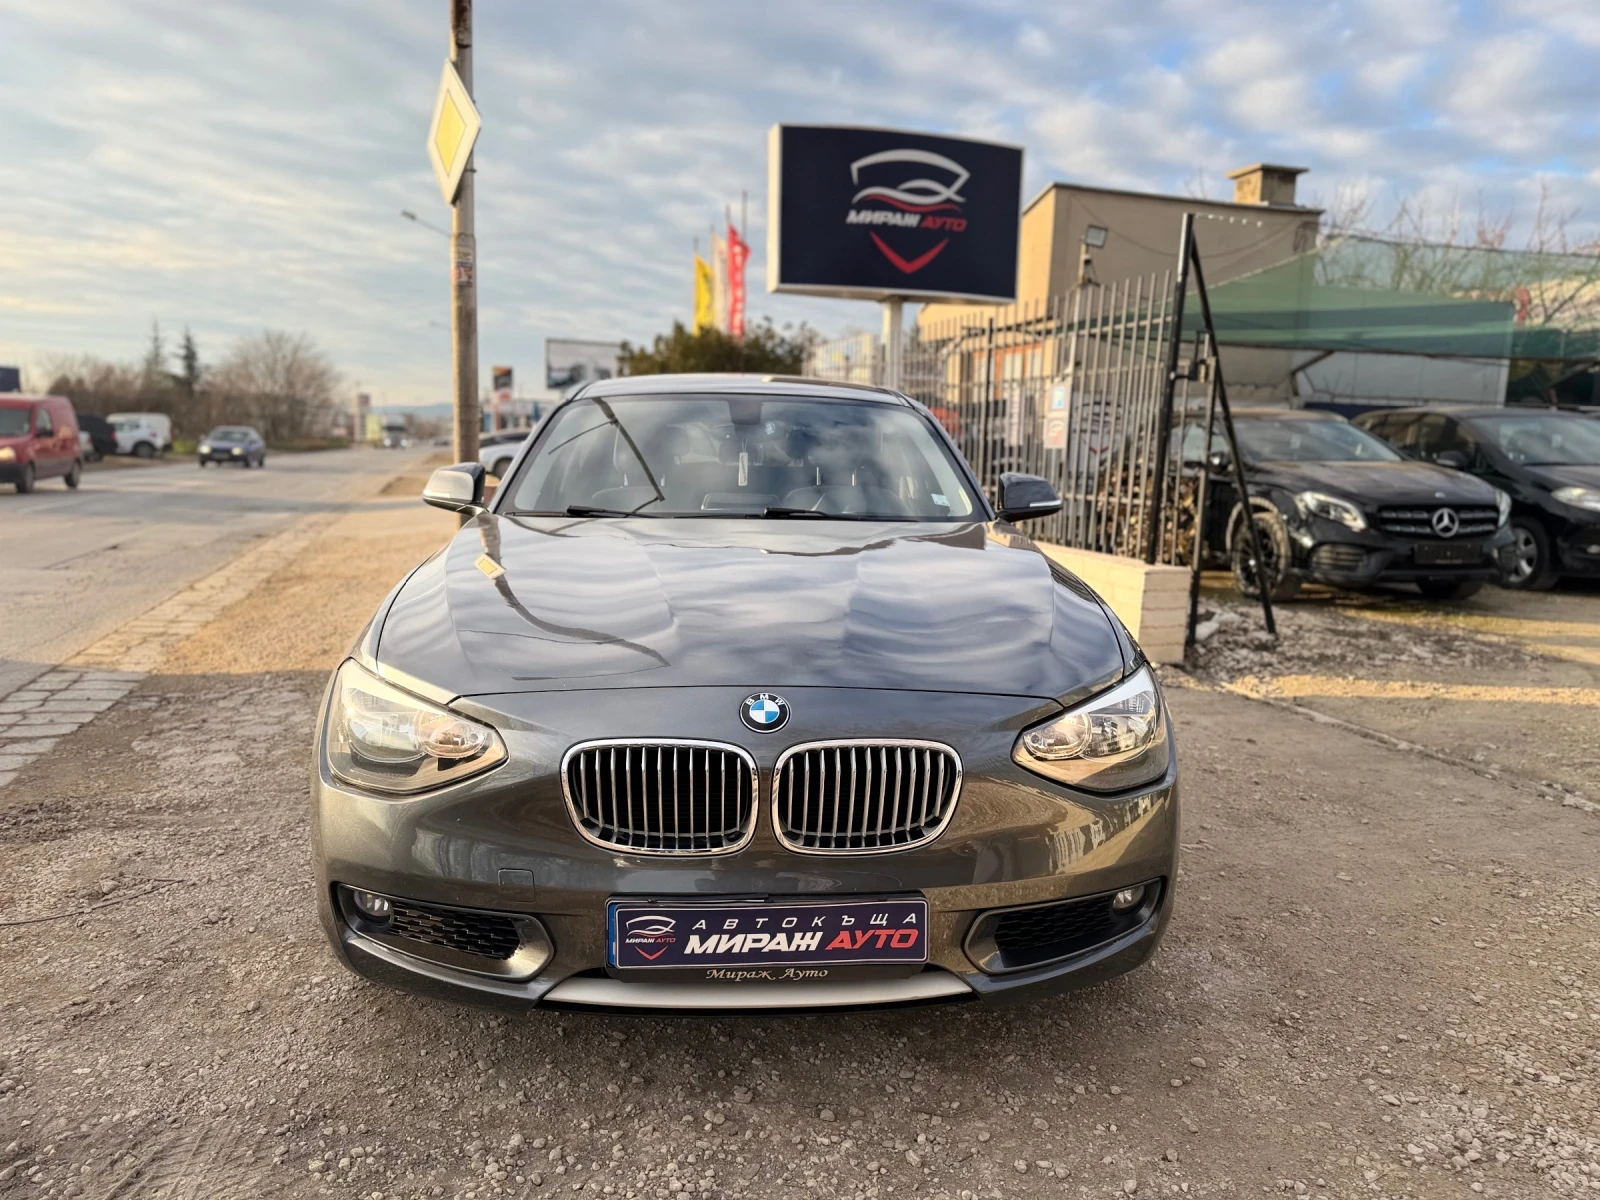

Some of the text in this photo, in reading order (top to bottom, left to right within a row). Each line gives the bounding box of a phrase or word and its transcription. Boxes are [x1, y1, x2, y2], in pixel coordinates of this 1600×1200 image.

[846, 210, 967, 231] МИРАЖ АУТО
[745, 694, 785, 706] BMW
[692, 913, 916, 930] АВТОКЪЩА
[684, 928, 919, 954] МИРАЖ АУТО
[706, 968, 828, 981] Мираж Ауто
